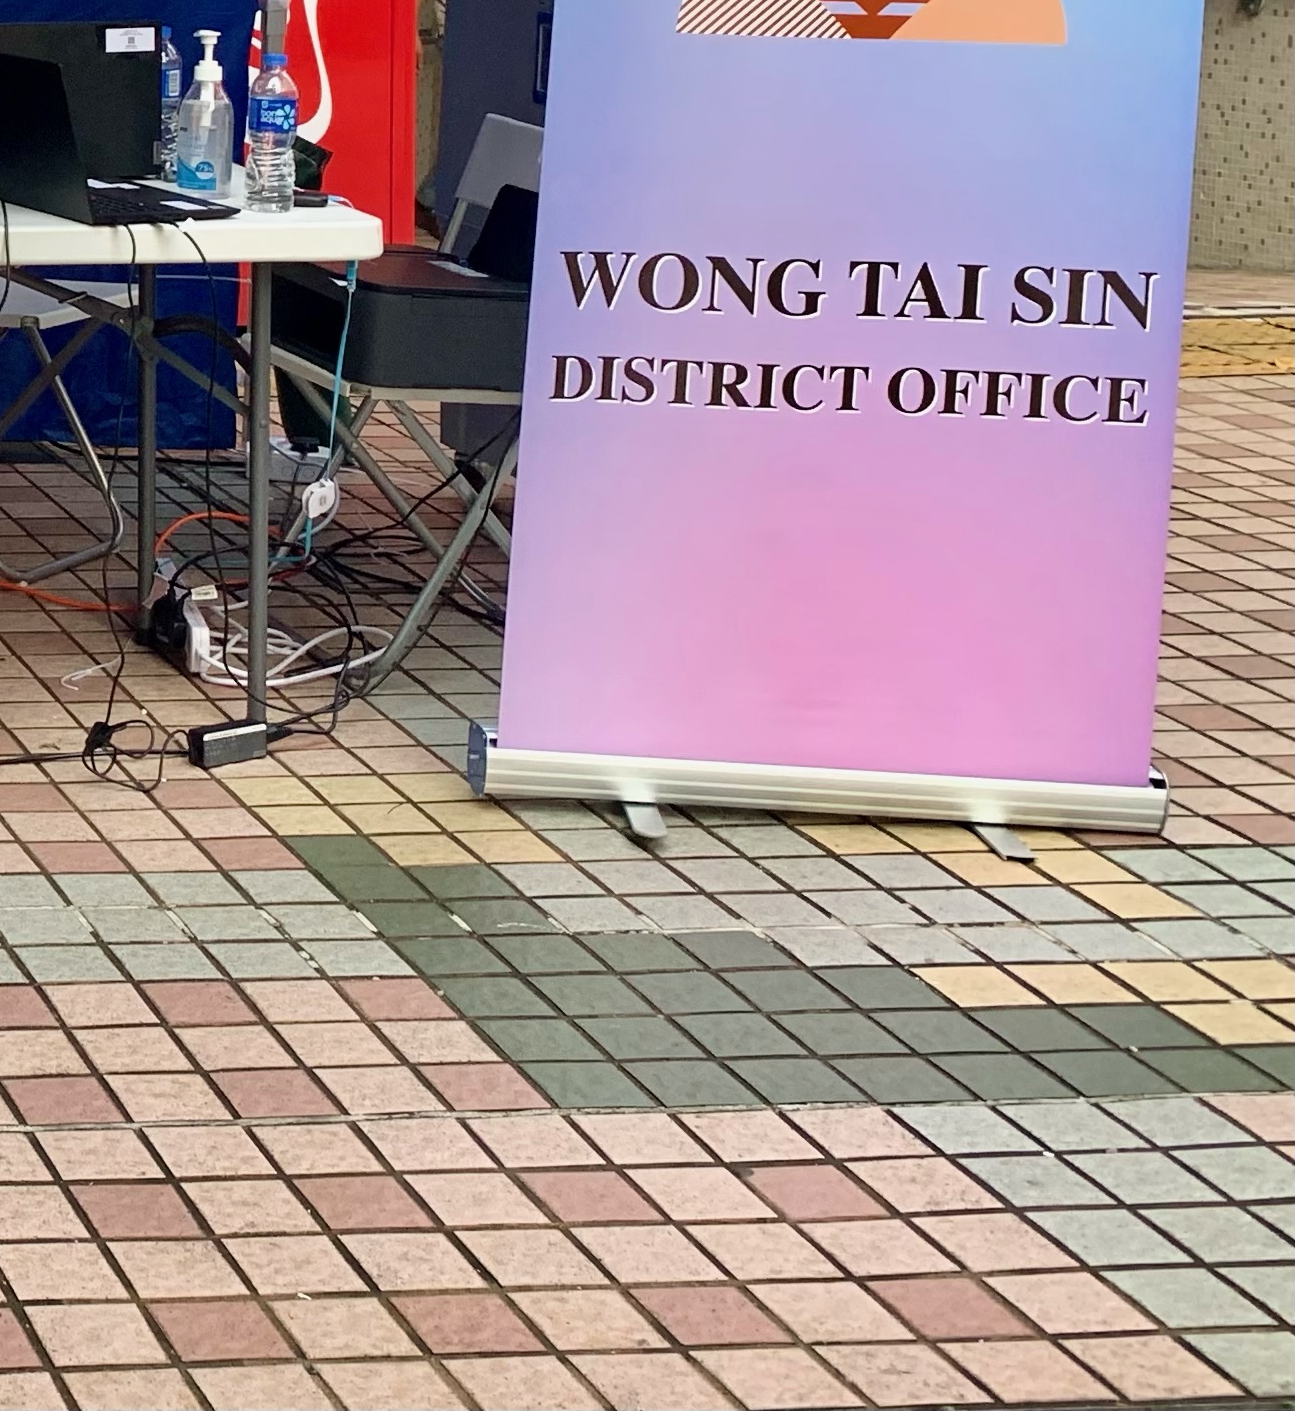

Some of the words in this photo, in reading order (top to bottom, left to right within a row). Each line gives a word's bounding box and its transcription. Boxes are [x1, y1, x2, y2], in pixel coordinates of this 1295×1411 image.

[560, 250, 828, 318] WONG
[848, 259, 988, 322] TAI
[1011, 264, 1160, 330] SIN
[549, 355, 870, 413] DISTRICT
[887, 366, 1150, 426] OFFICE
